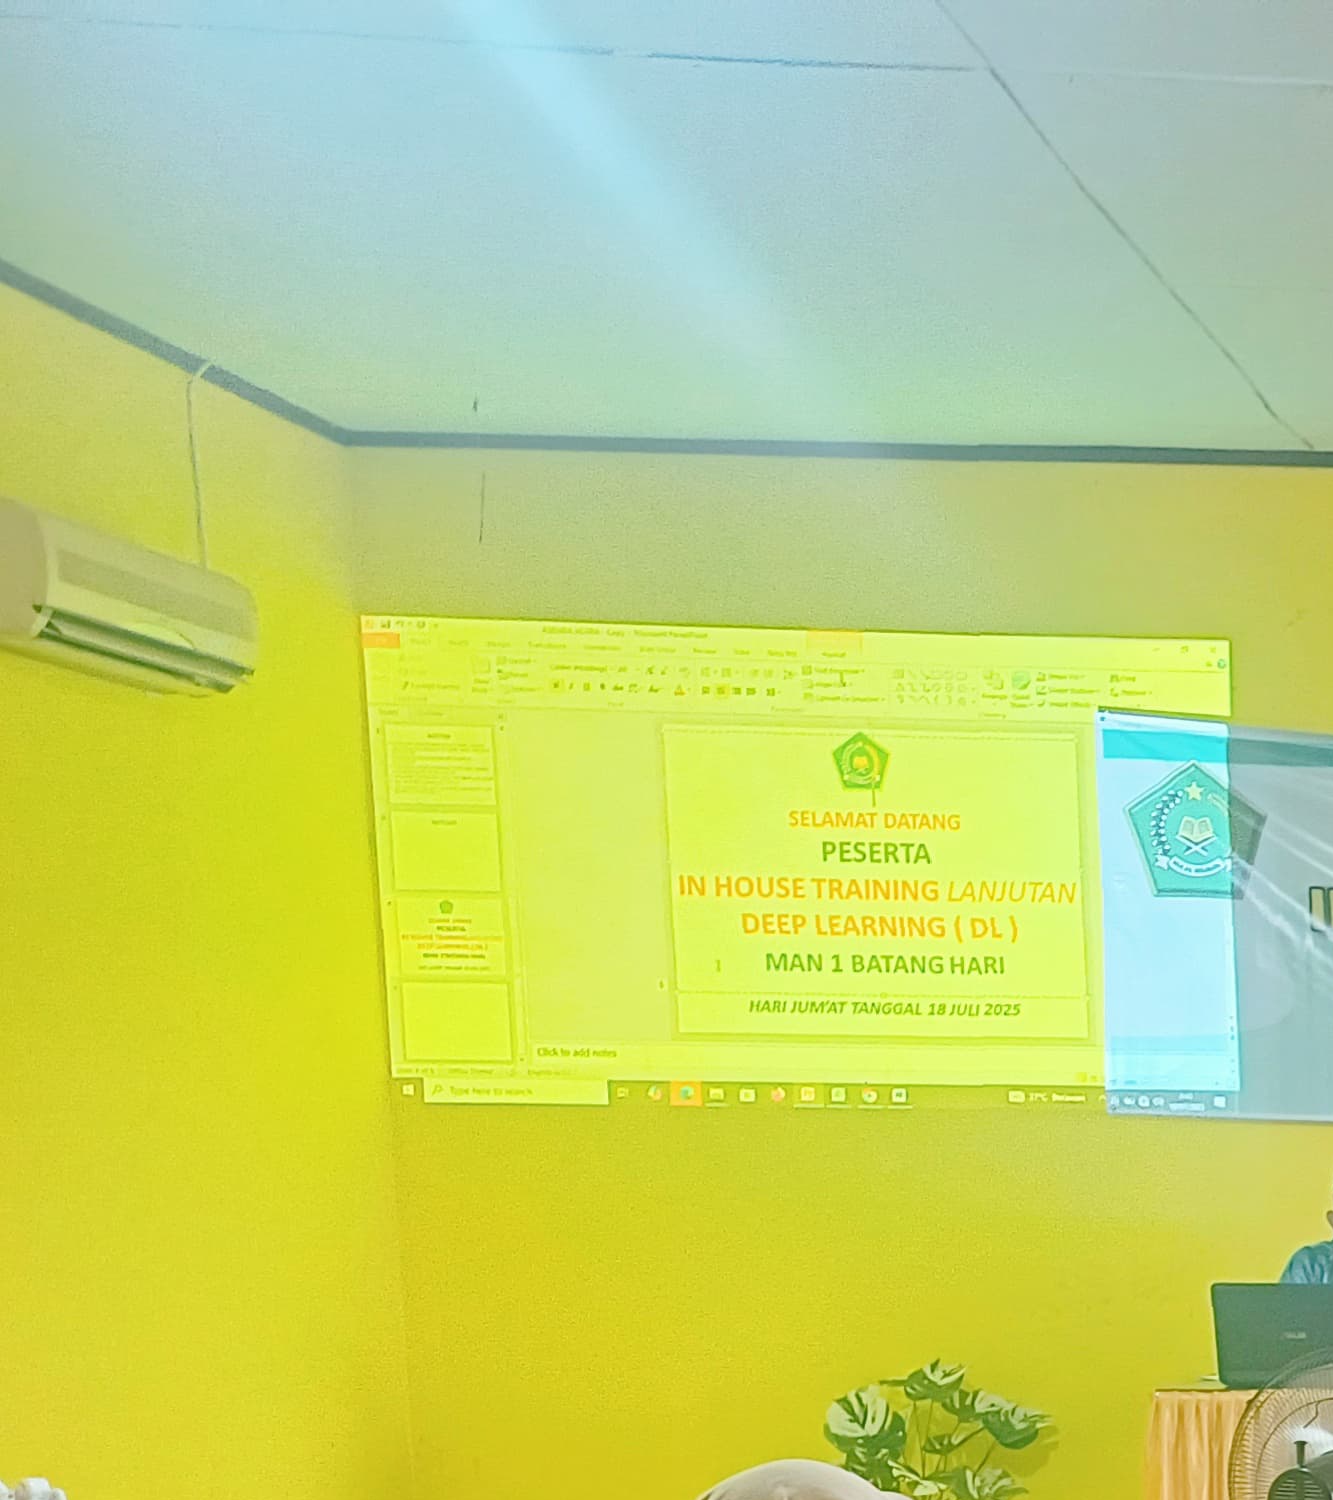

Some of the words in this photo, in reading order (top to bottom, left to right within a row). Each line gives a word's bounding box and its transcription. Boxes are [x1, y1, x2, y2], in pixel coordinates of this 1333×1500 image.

[788, 810, 878, 829] SELAMAT
[883, 812, 961, 832] DATANG
[822, 840, 932, 864] PESERTA
[678, 874, 706, 897] IN
[714, 876, 807, 899] HOUSE
[811, 878, 940, 902] TRAINING
[946, 880, 1077, 904] LANJUTAN
[741, 912, 807, 935] DEEP
[814, 914, 947, 938] LEARNING
[765, 952, 823, 973] MAN
[830, 953, 844, 973] 1
[850, 954, 945, 975] BATANG
[949, 955, 1006, 975] HARI
[749, 999, 787, 1014] HARI
[851, 1001, 923, 1016] TANGGAL
[927, 1002, 947, 1016] 18
[949, 1002, 980, 1018] JULI
[984, 1003, 1021, 1017] 2025
